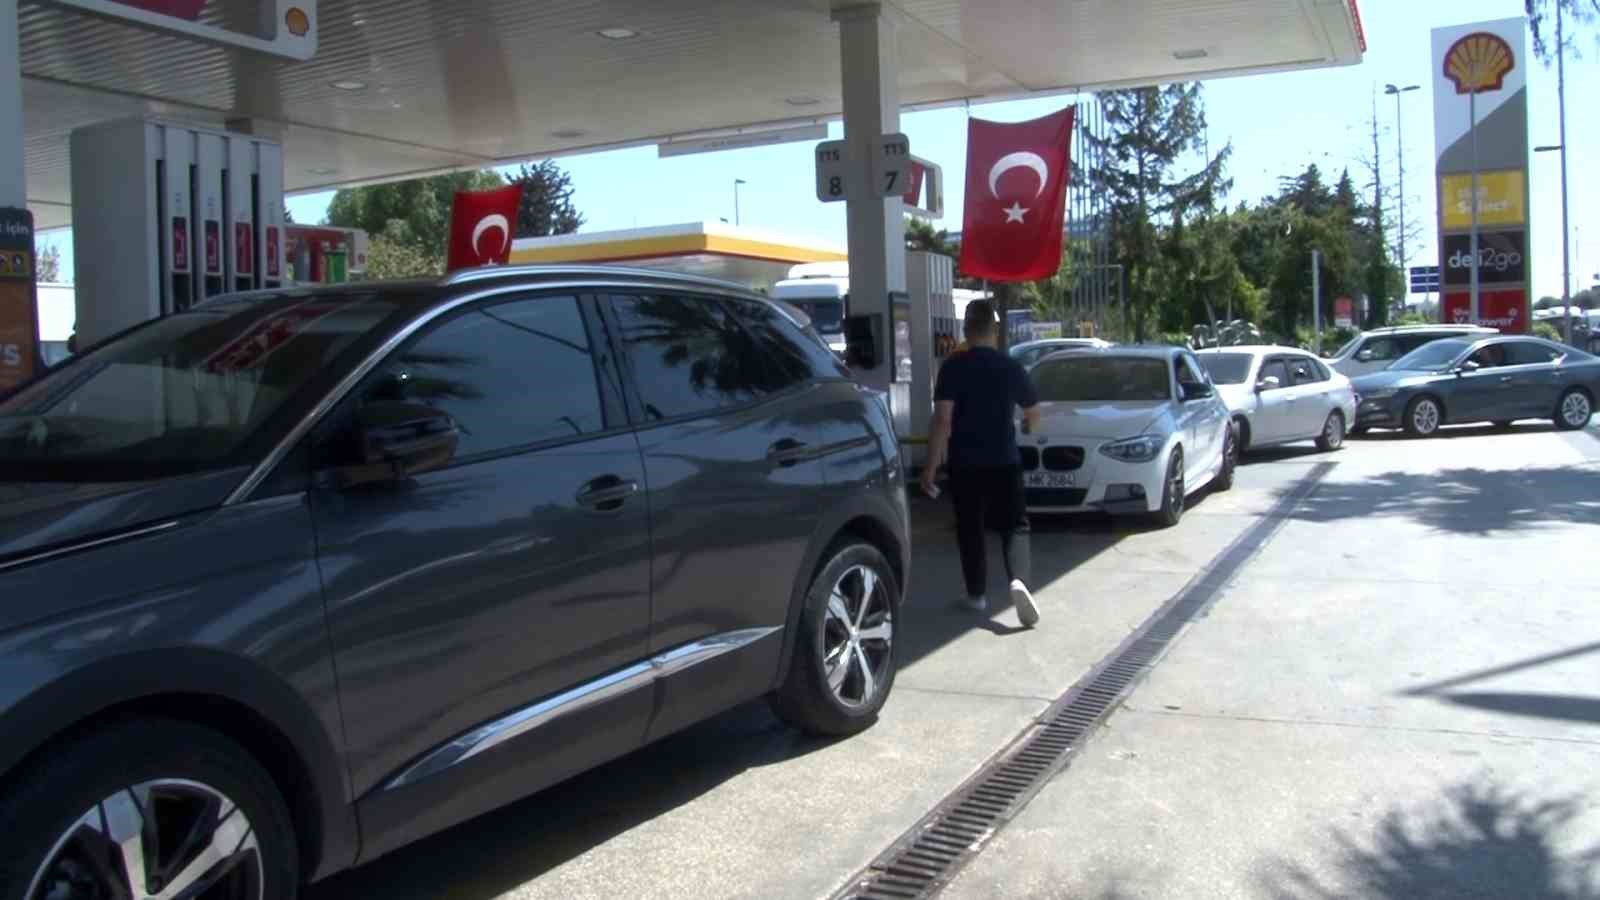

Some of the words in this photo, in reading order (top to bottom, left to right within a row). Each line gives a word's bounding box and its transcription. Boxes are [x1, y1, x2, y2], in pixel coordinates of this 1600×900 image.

[828, 175, 843, 197] 8
[885, 170, 899, 192] 7
[1448, 247, 1521, 271] dei2go
